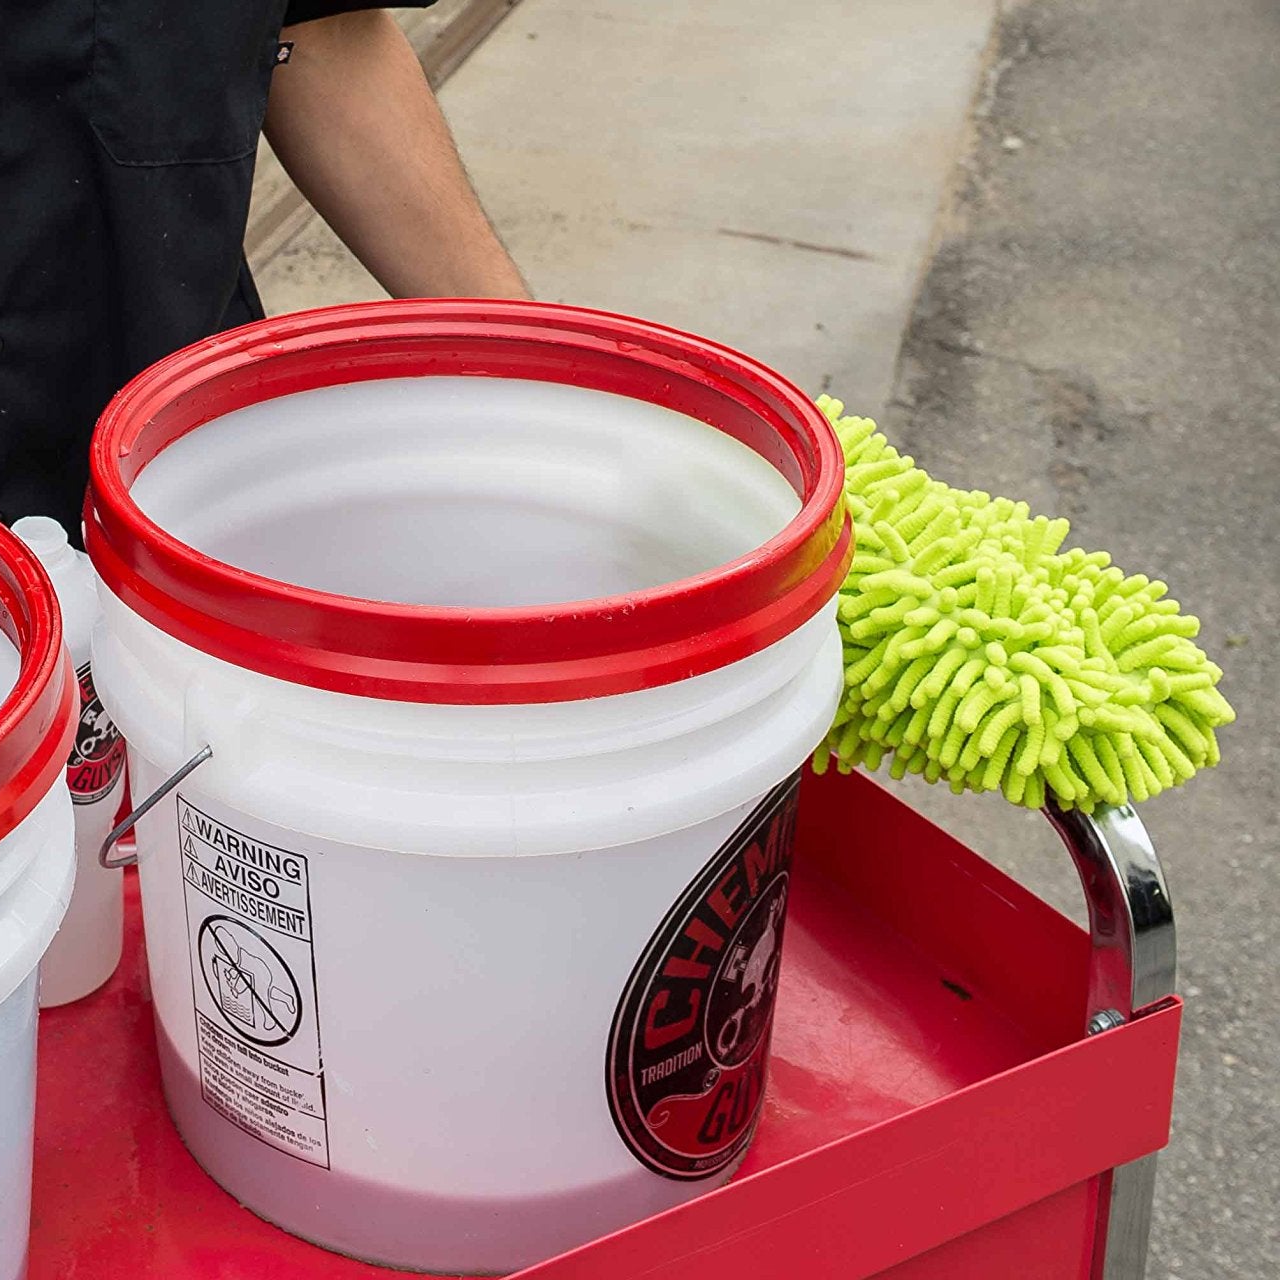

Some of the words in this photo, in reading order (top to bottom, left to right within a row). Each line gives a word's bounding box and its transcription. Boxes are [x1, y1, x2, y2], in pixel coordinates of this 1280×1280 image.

[195, 814, 301, 880] WARNING
[201, 870, 306, 935] AVERTISSEMENT
[214, 855, 280, 899] AVISO
[640, 1041, 703, 1086] TRADITION
